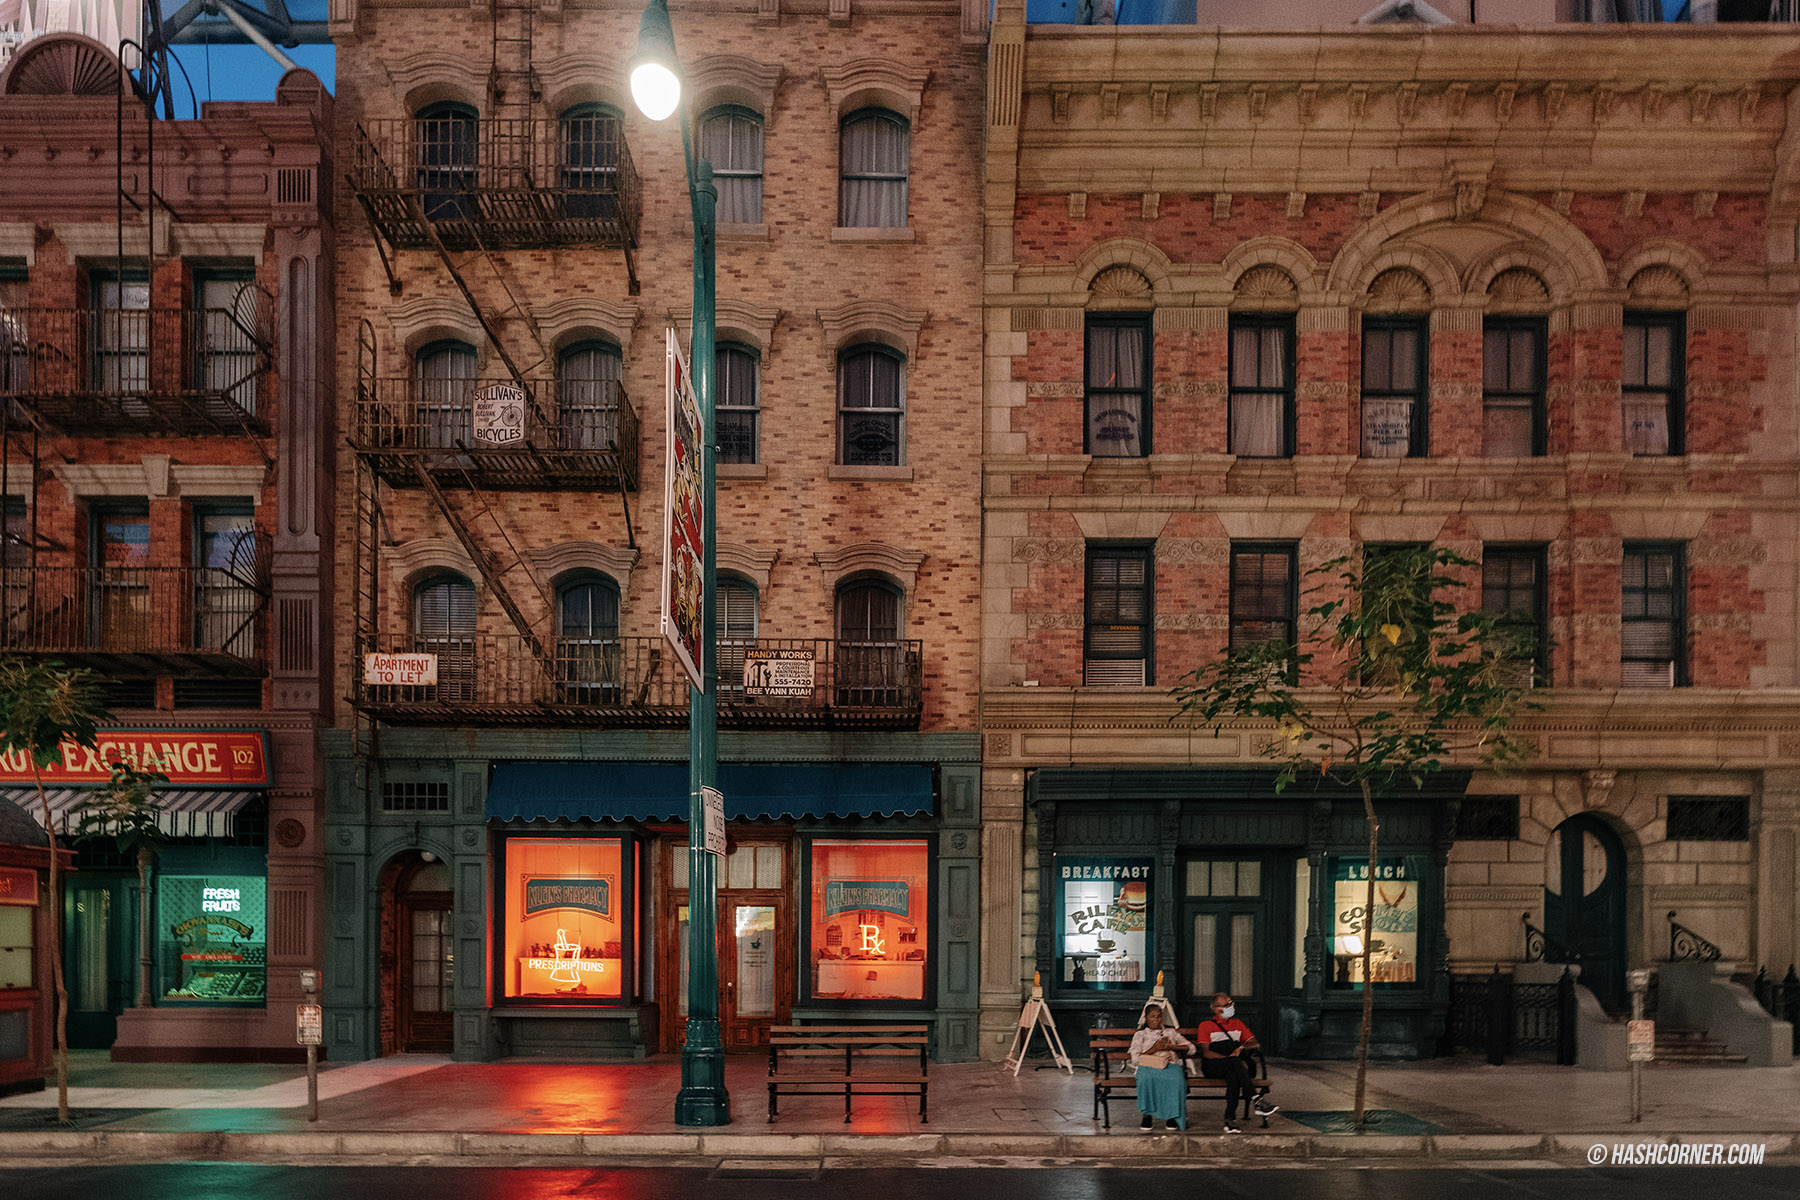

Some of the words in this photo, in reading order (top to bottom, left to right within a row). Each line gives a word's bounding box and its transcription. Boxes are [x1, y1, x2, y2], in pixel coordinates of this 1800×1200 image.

[475, 386, 522, 400] SULLIVAN'S
[477, 429, 521, 441] BICYCLES
[747, 651, 778, 659] HANDY
[780, 651, 813, 659] WORKS
[373, 655, 429, 671] APARTMENT
[377, 671, 394, 682] TO
[400, 671, 424, 683] LET
[747, 687, 763, 695] BEE
[788, 688, 812, 696] KUAH
[62, 742, 222, 773] EXCHANGE
[232, 750, 255, 764] 102
[1062, 866, 1149, 879] BREAKFAST
[203, 888, 240, 900] FRESH
[563, 886, 608, 909] PHARMACY
[863, 888, 908, 910] PHARMACY
[202, 900, 240, 912] FRUITS
[1071, 904, 1143, 927] RILEY'S
[1340, 904, 1411, 923] COFEE
[1078, 918, 1131, 935] CAFE
[529, 959, 604, 972] PRESCRIPTIONS
